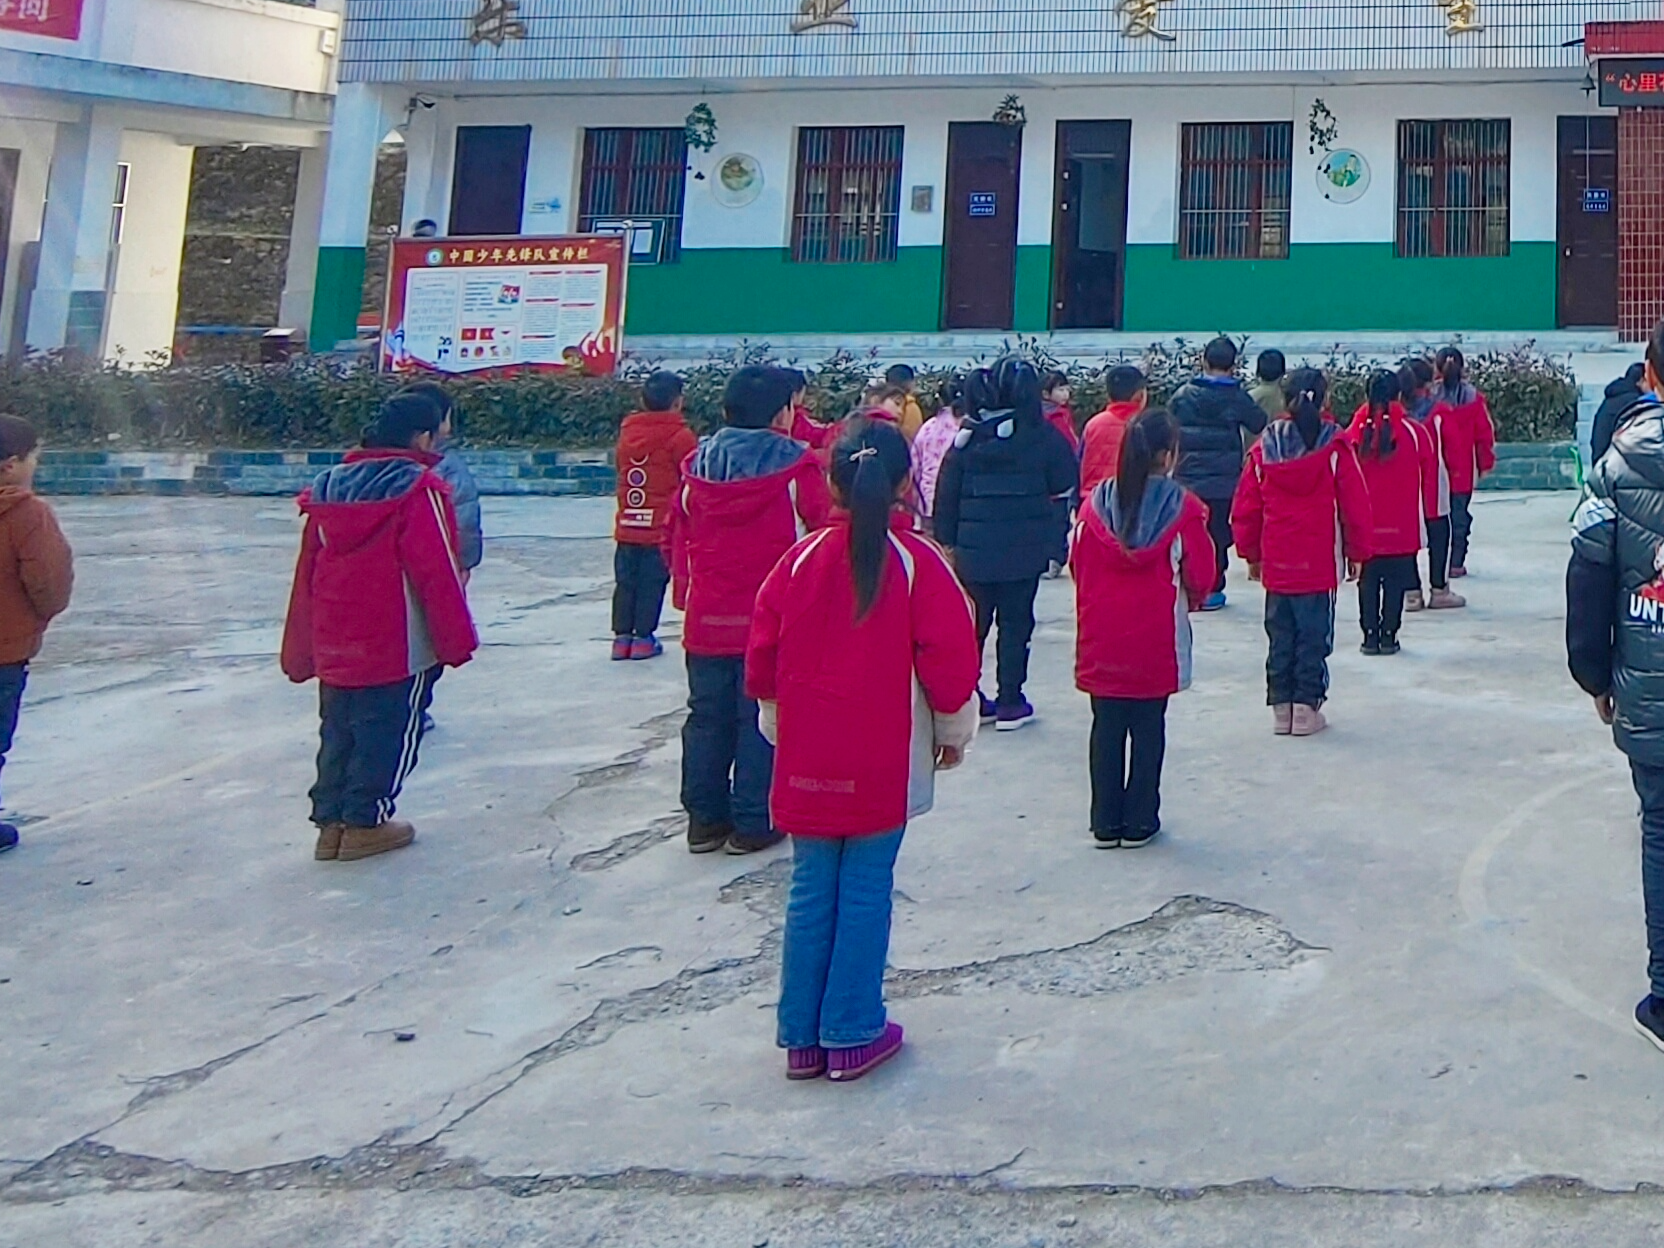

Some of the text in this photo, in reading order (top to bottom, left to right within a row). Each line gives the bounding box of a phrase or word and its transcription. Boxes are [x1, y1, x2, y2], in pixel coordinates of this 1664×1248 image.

[449, 245, 589, 264] 中国少年先锋队宣传栏
